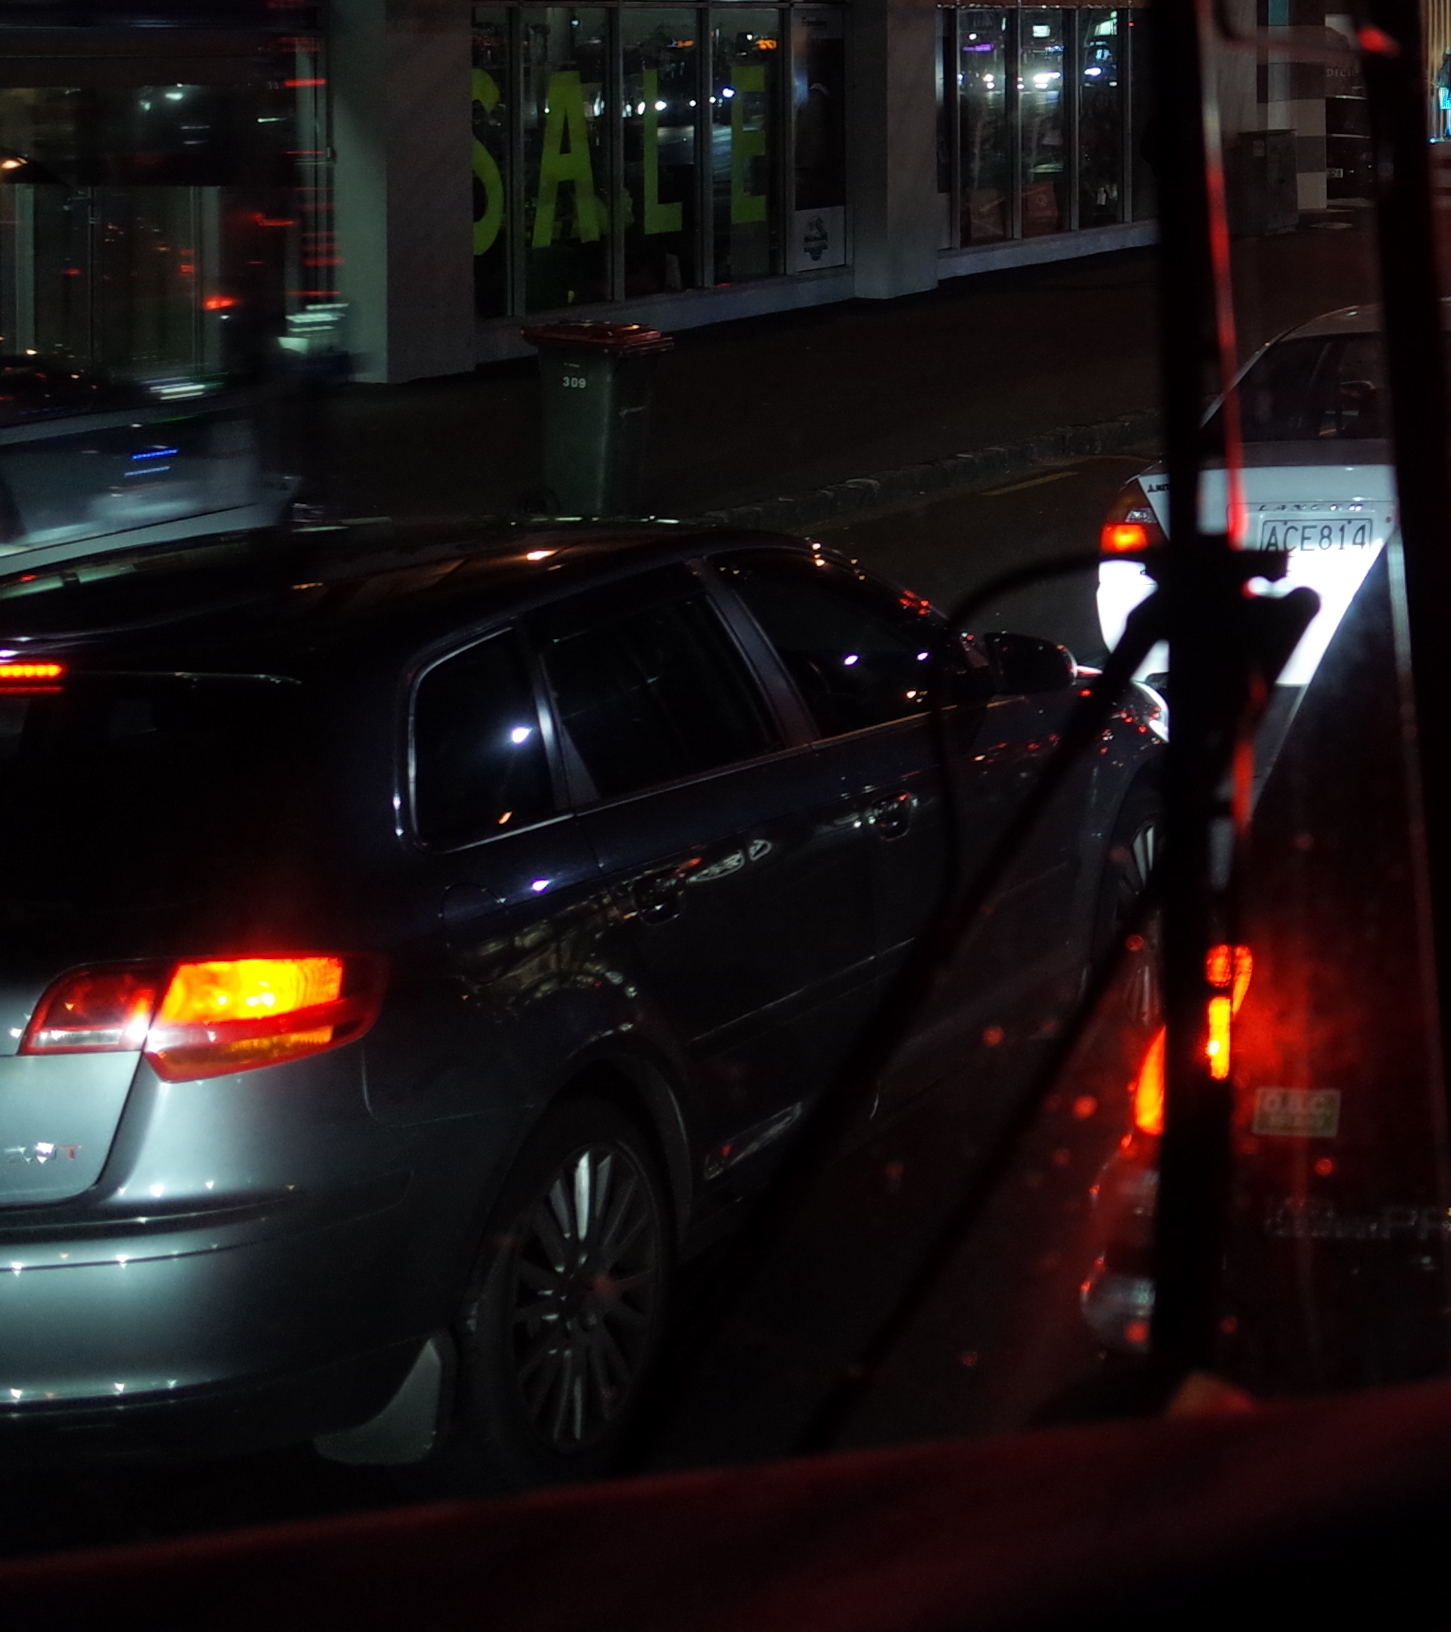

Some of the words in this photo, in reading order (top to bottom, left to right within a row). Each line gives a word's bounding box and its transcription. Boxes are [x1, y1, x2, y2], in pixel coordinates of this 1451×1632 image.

[471, 65, 768, 257] SALE
[562, 375, 587, 389] 309
[1266, 524, 1367, 553] ACE814
